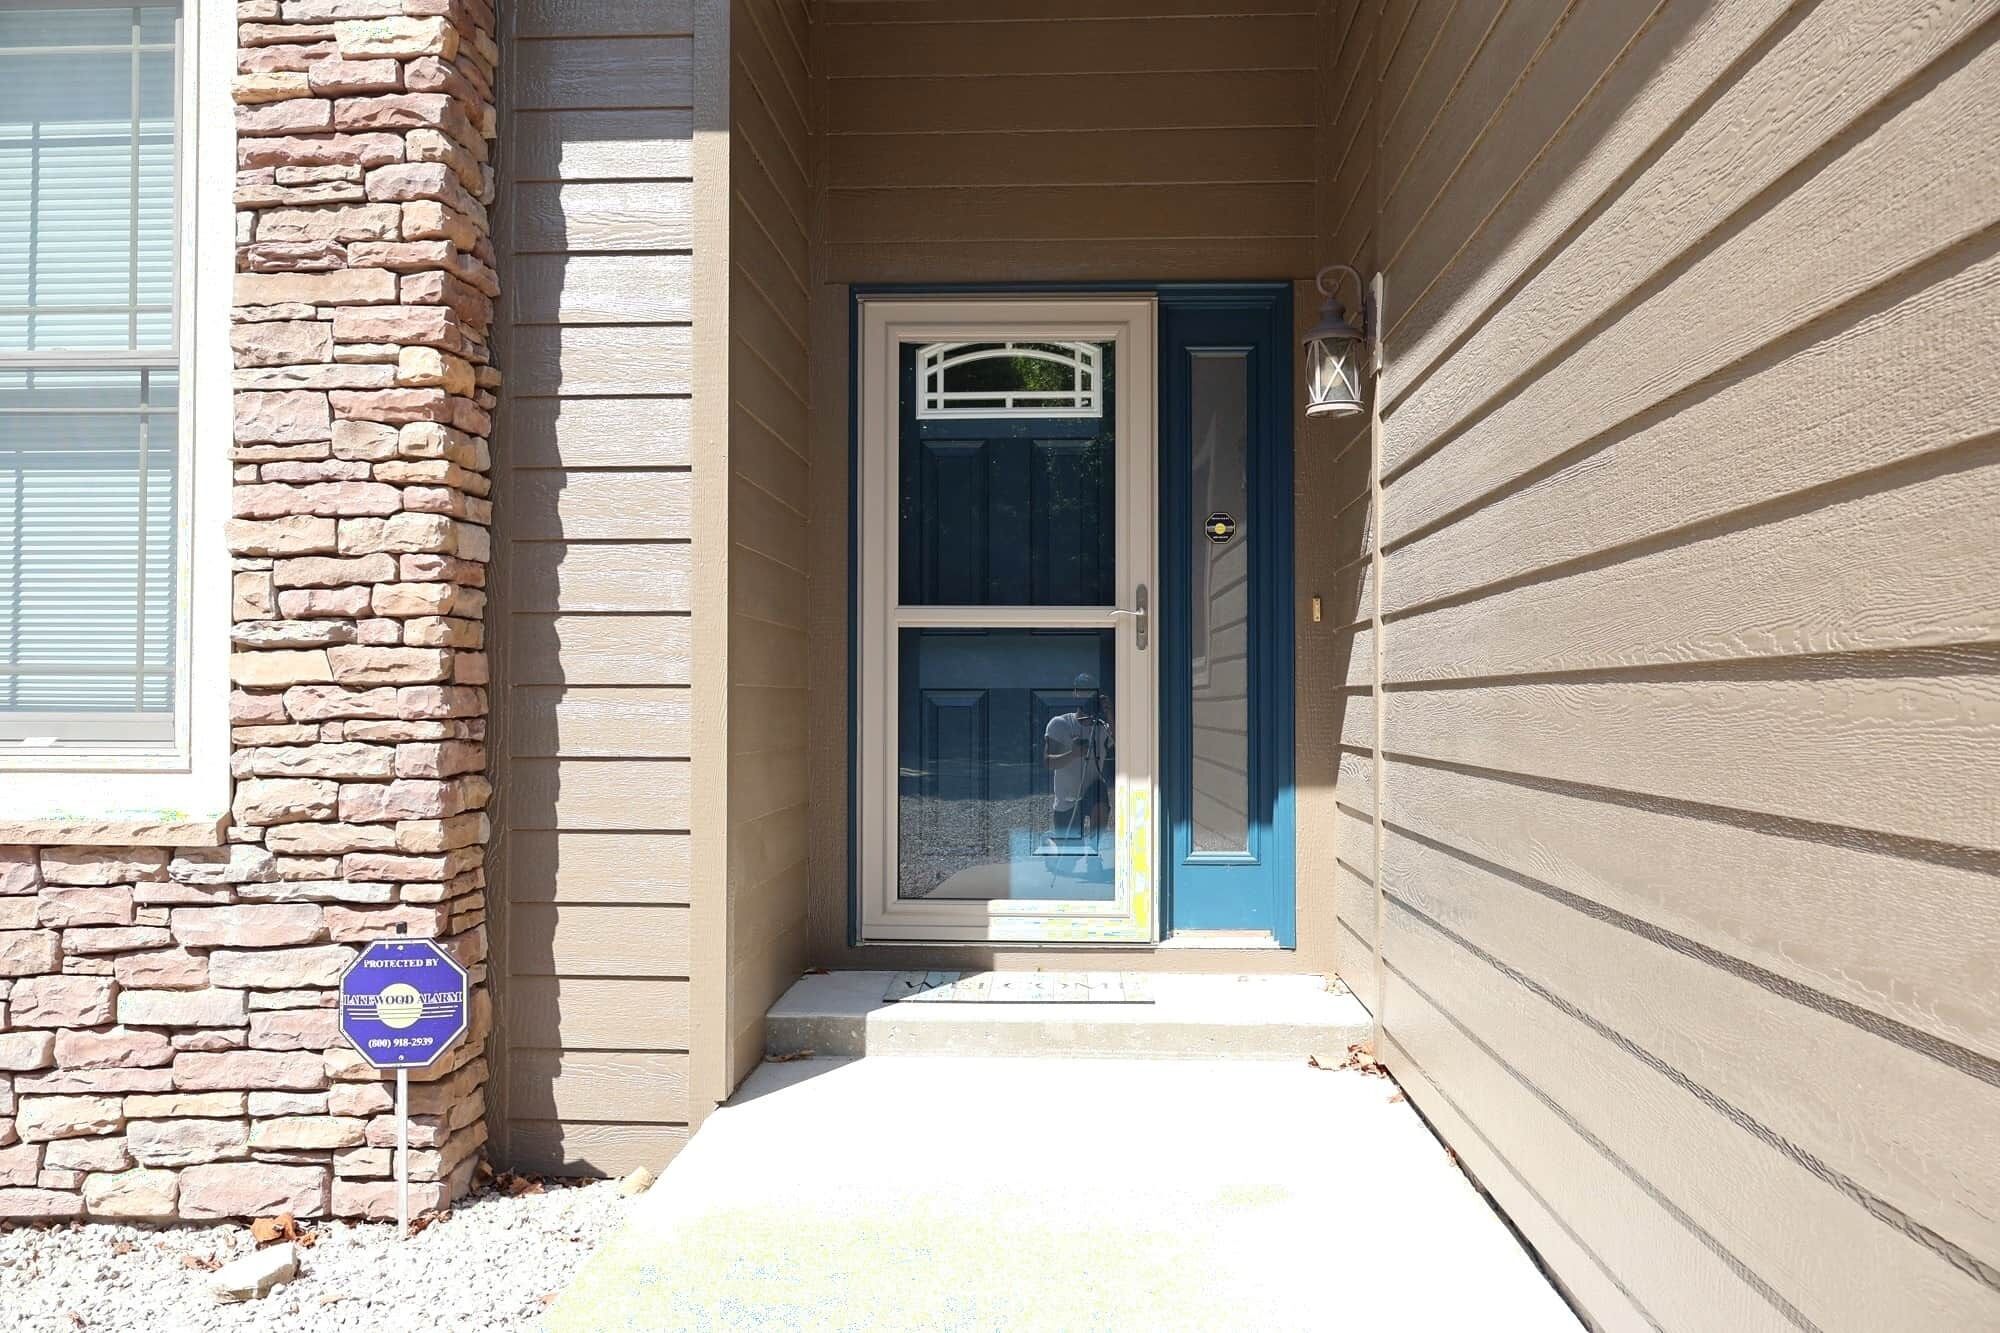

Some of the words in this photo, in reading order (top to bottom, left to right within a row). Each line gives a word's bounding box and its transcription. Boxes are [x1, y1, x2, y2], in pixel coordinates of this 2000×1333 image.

[363, 959, 424, 968] PROTECTED
[425, 958, 440, 967] BY
[343, 994, 414, 1006] LAKEWOOD
[417, 992, 463, 1004] ALARM
[368, 1038, 391, 1048] (800)
[393, 1037, 434, 1047] 918-2939
